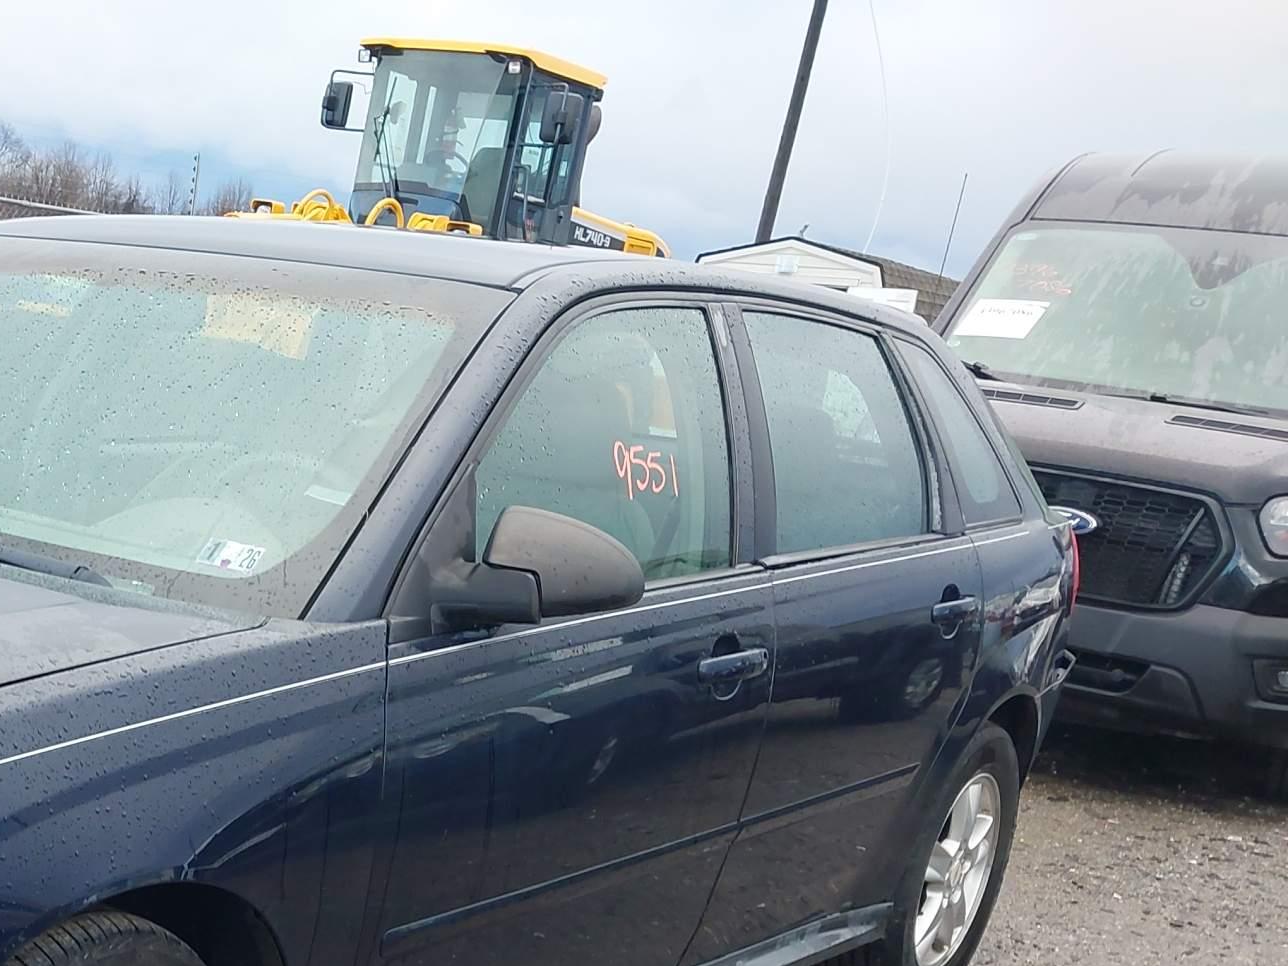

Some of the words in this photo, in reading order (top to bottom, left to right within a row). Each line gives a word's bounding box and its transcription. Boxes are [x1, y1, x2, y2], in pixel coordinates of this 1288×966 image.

[574, 225, 611, 248] HL740-9
[613, 440, 679, 500] 9551
[239, 549, 261, 569] 26
